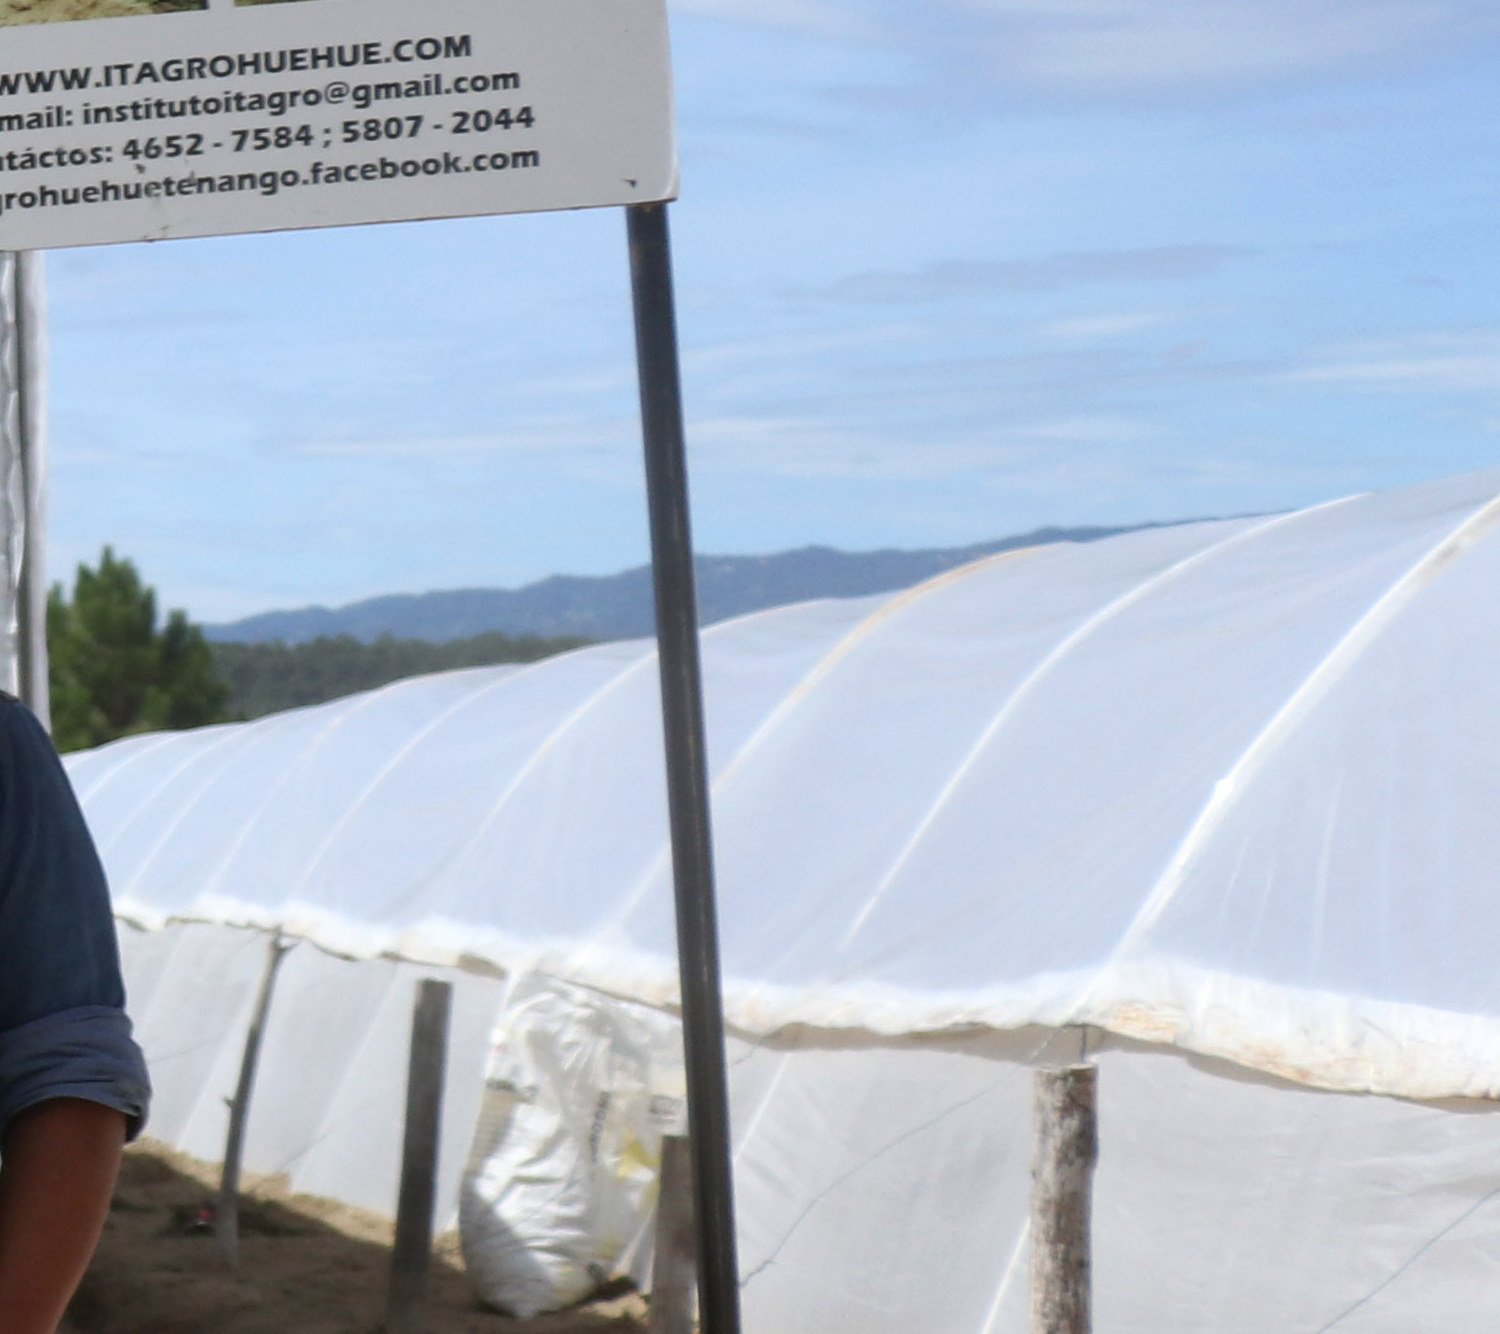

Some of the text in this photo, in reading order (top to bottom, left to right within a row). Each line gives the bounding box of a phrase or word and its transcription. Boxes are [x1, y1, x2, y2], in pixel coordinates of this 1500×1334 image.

[83, 71, 521, 125] institutoitagro@gmail.com
[123, 133, 204, 161] 4652
[231, 124, 314, 153] 7584
[341, 115, 425, 144] 5807
[451, 106, 536, 134] 2044
